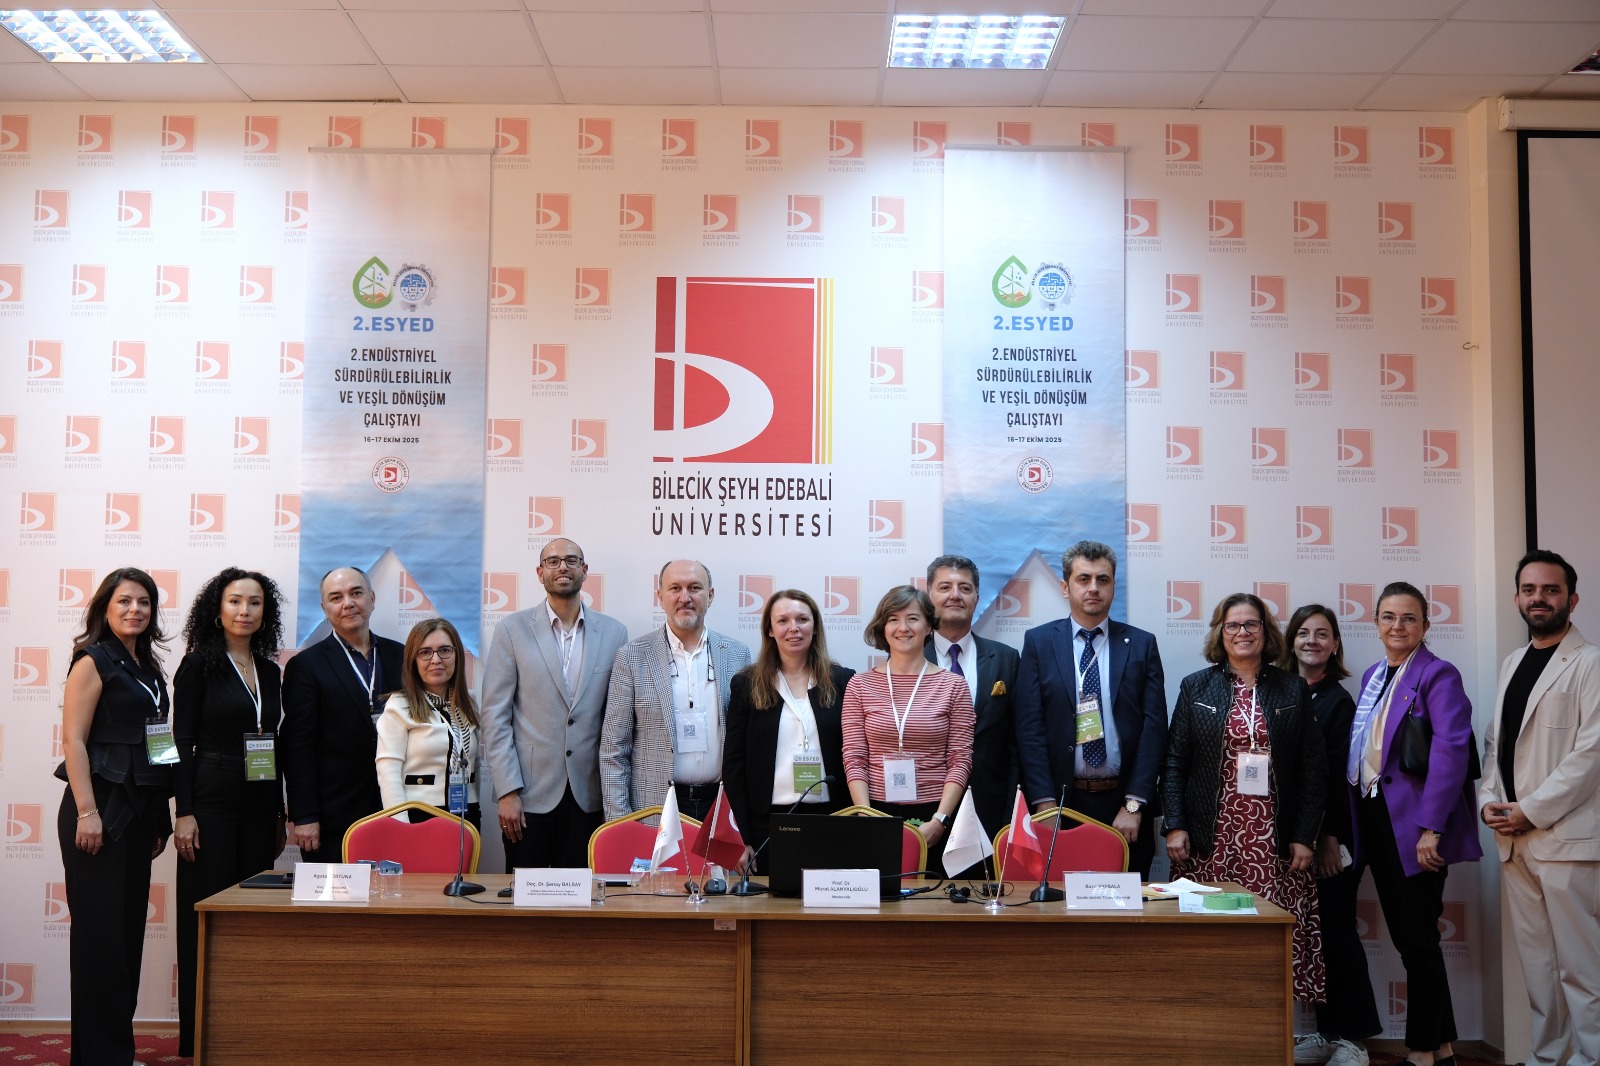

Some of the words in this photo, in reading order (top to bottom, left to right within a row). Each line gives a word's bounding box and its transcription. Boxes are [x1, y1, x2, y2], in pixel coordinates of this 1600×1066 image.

[353, 316, 434, 332] 2.ESYED
[993, 316, 1073, 331] 2.ESYED
[351, 347, 436, 363] 2.ENDÜSTRİYEL
[992, 347, 1077, 362] 2.ENDÜSTRİYEL
[335, 369, 452, 384] SÜRDÜRÜLEBİLİRLİK
[977, 368, 1092, 383] SÜRDÜRÜLEBİLİRLİK
[339, 391, 353, 404] VE
[357, 390, 388, 407] YEŞİL
[392, 390, 446, 407] DÖNÜŞÜM
[982, 391, 996, 403] VE
[1000, 390, 1030, 406] YEŞİL
[1034, 390, 1087, 407] DÖNÜŞÜM
[364, 412, 420, 428] ÇALIŞTAYI
[1007, 412, 1063, 428] ÇALIŞTAYI
[653, 471, 712, 499] BİLECİK
[719, 477, 758, 506] ŞEYH
[766, 472, 832, 501] EDEBALİ
[652, 507, 832, 537] ÜNİVERSİTESİ
